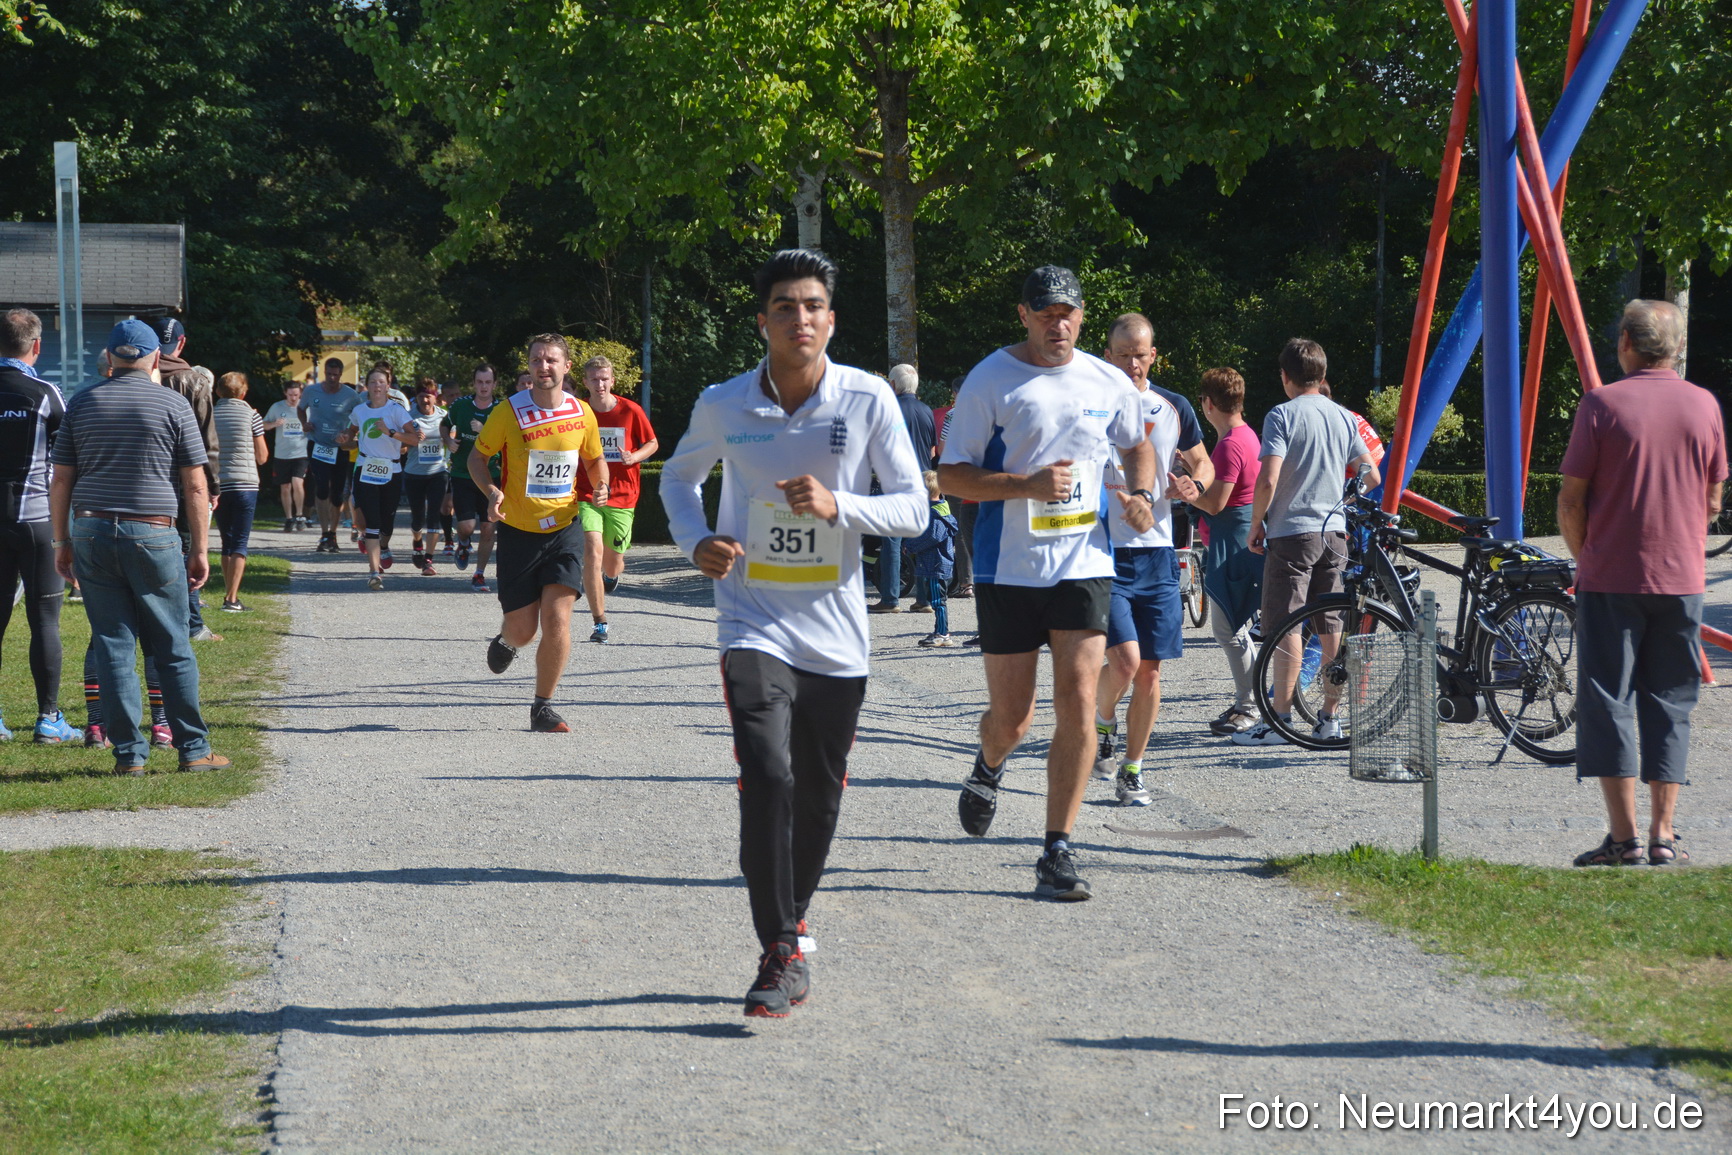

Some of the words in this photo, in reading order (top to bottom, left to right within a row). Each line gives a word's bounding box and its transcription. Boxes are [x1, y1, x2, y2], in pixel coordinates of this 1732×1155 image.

[522, 427, 554, 443] MAX
[557, 420, 586, 434] BÖGL
[724, 432, 775, 445] Waitrose
[366, 463, 389, 475] 2260
[535, 463, 571, 479] 2412
[1049, 516, 1081, 528] Gerhard
[769, 526, 816, 554] 351
[765, 555, 785, 563] PARTL
